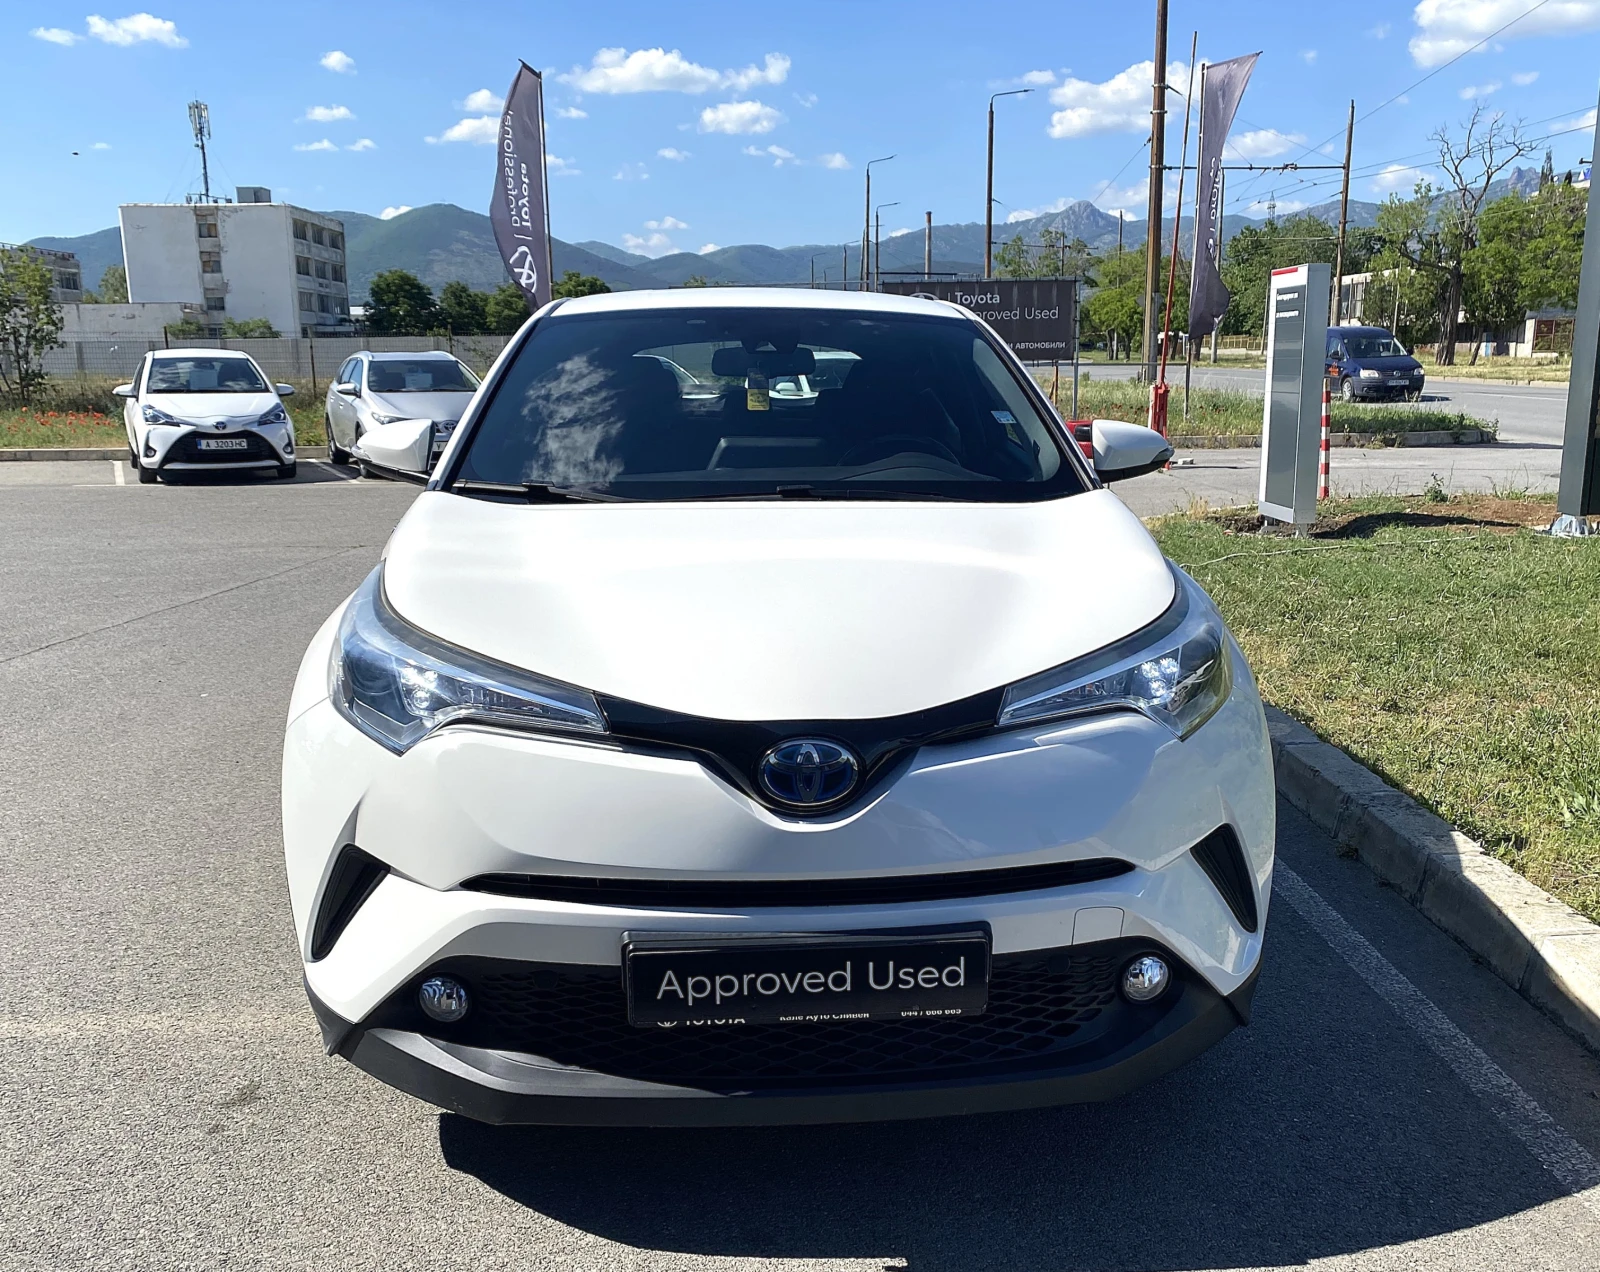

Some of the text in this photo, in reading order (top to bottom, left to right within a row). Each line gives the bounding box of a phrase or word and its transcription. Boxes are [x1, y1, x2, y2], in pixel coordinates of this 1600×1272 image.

[955, 292, 1000, 307] Toyota
[1025, 306, 1059, 319] Used
[1015, 341, 1066, 349] АВТОМОБИЛИ
[656, 956, 965, 1006] Approved Used
